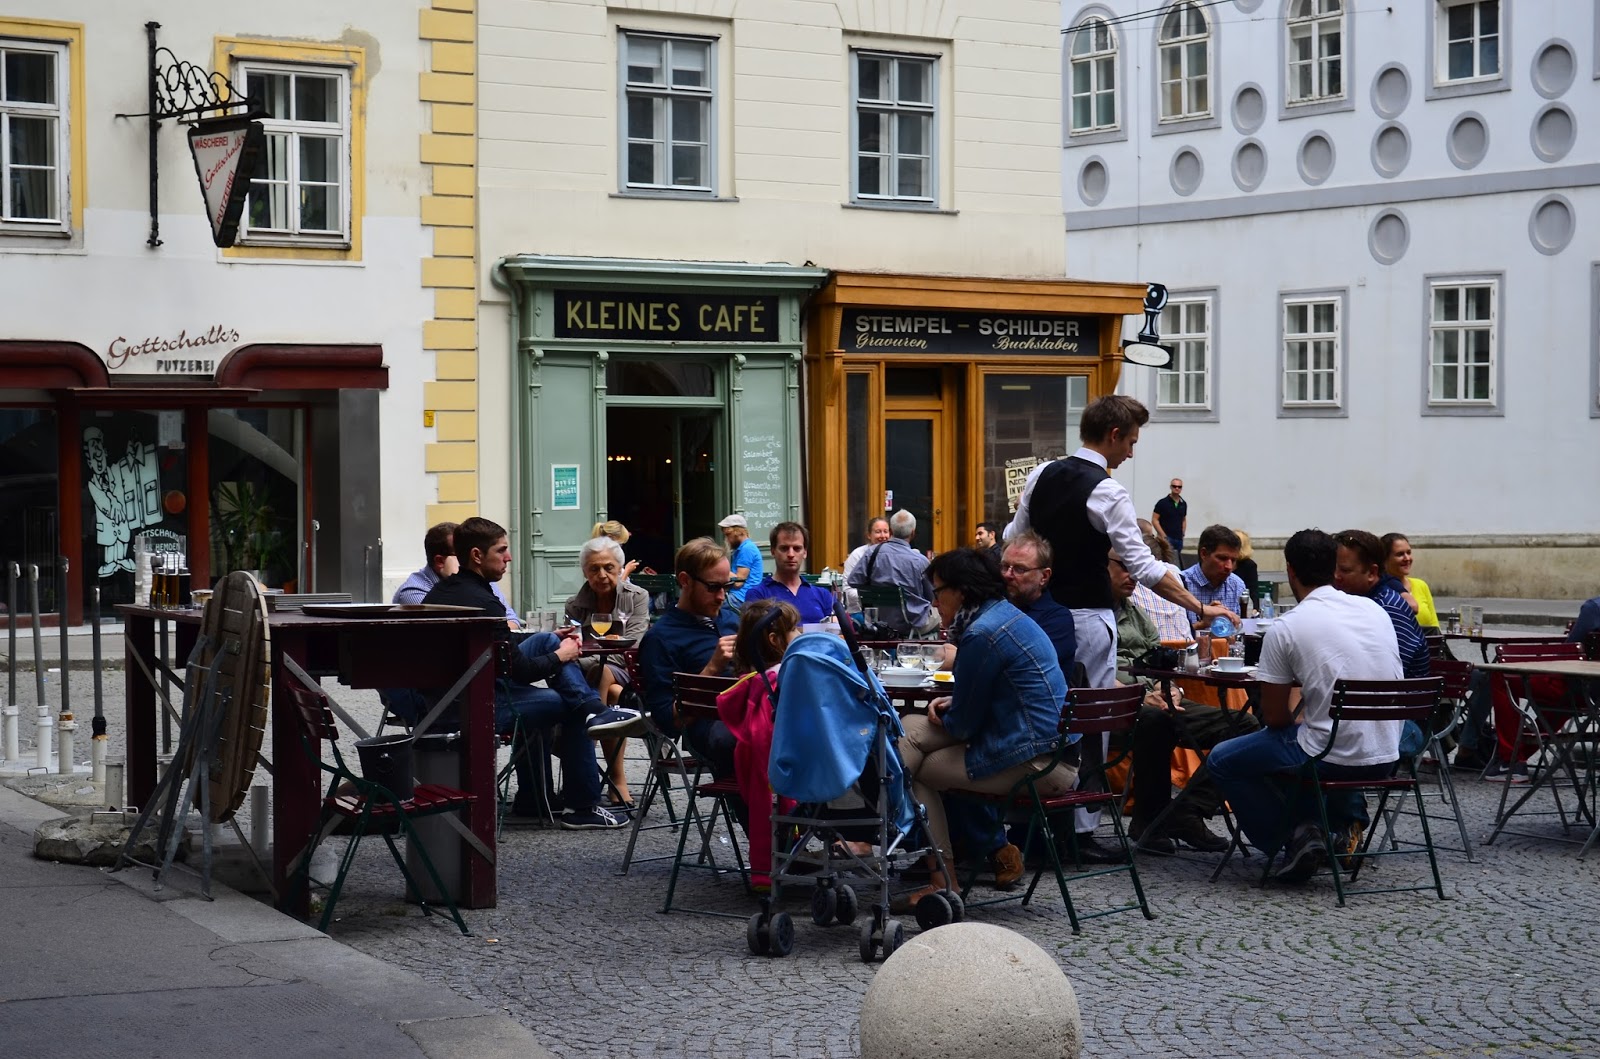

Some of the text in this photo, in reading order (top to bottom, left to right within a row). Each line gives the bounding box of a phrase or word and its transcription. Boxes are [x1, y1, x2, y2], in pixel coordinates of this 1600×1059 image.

[194, 136, 229, 149] WÄSCHEREI
[216, 170, 235, 225] PUTZEREI
[567, 300, 765, 333] KLEINES CAFÉ
[855, 315, 952, 334] STEMPEL
[979, 318, 1079, 337] SCHILDER
[106, 324, 240, 370] Gottschalk's
[855, 332, 1079, 352] Gravuren Buchstaben
[156, 359, 214, 372] PUTZEREI
